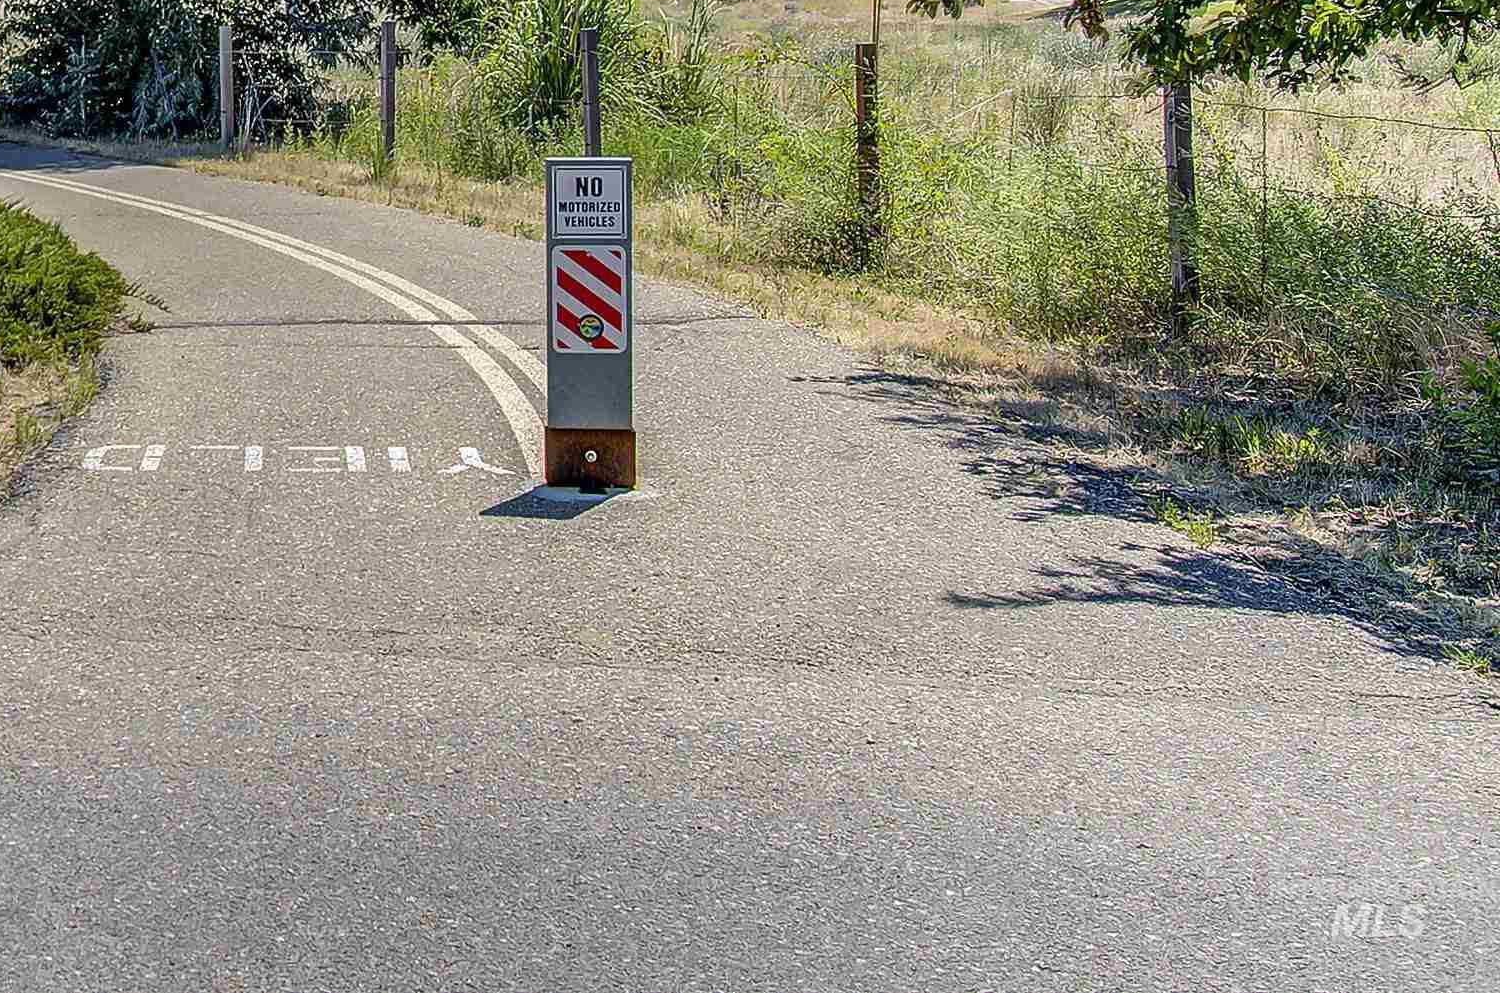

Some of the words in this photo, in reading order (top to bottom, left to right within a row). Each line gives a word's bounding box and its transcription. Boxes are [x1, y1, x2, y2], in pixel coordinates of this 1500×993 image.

[575, 176, 603, 197] NO
[558, 201, 620, 213] MOTORIZED
[564, 216, 616, 227] VEHICLES
